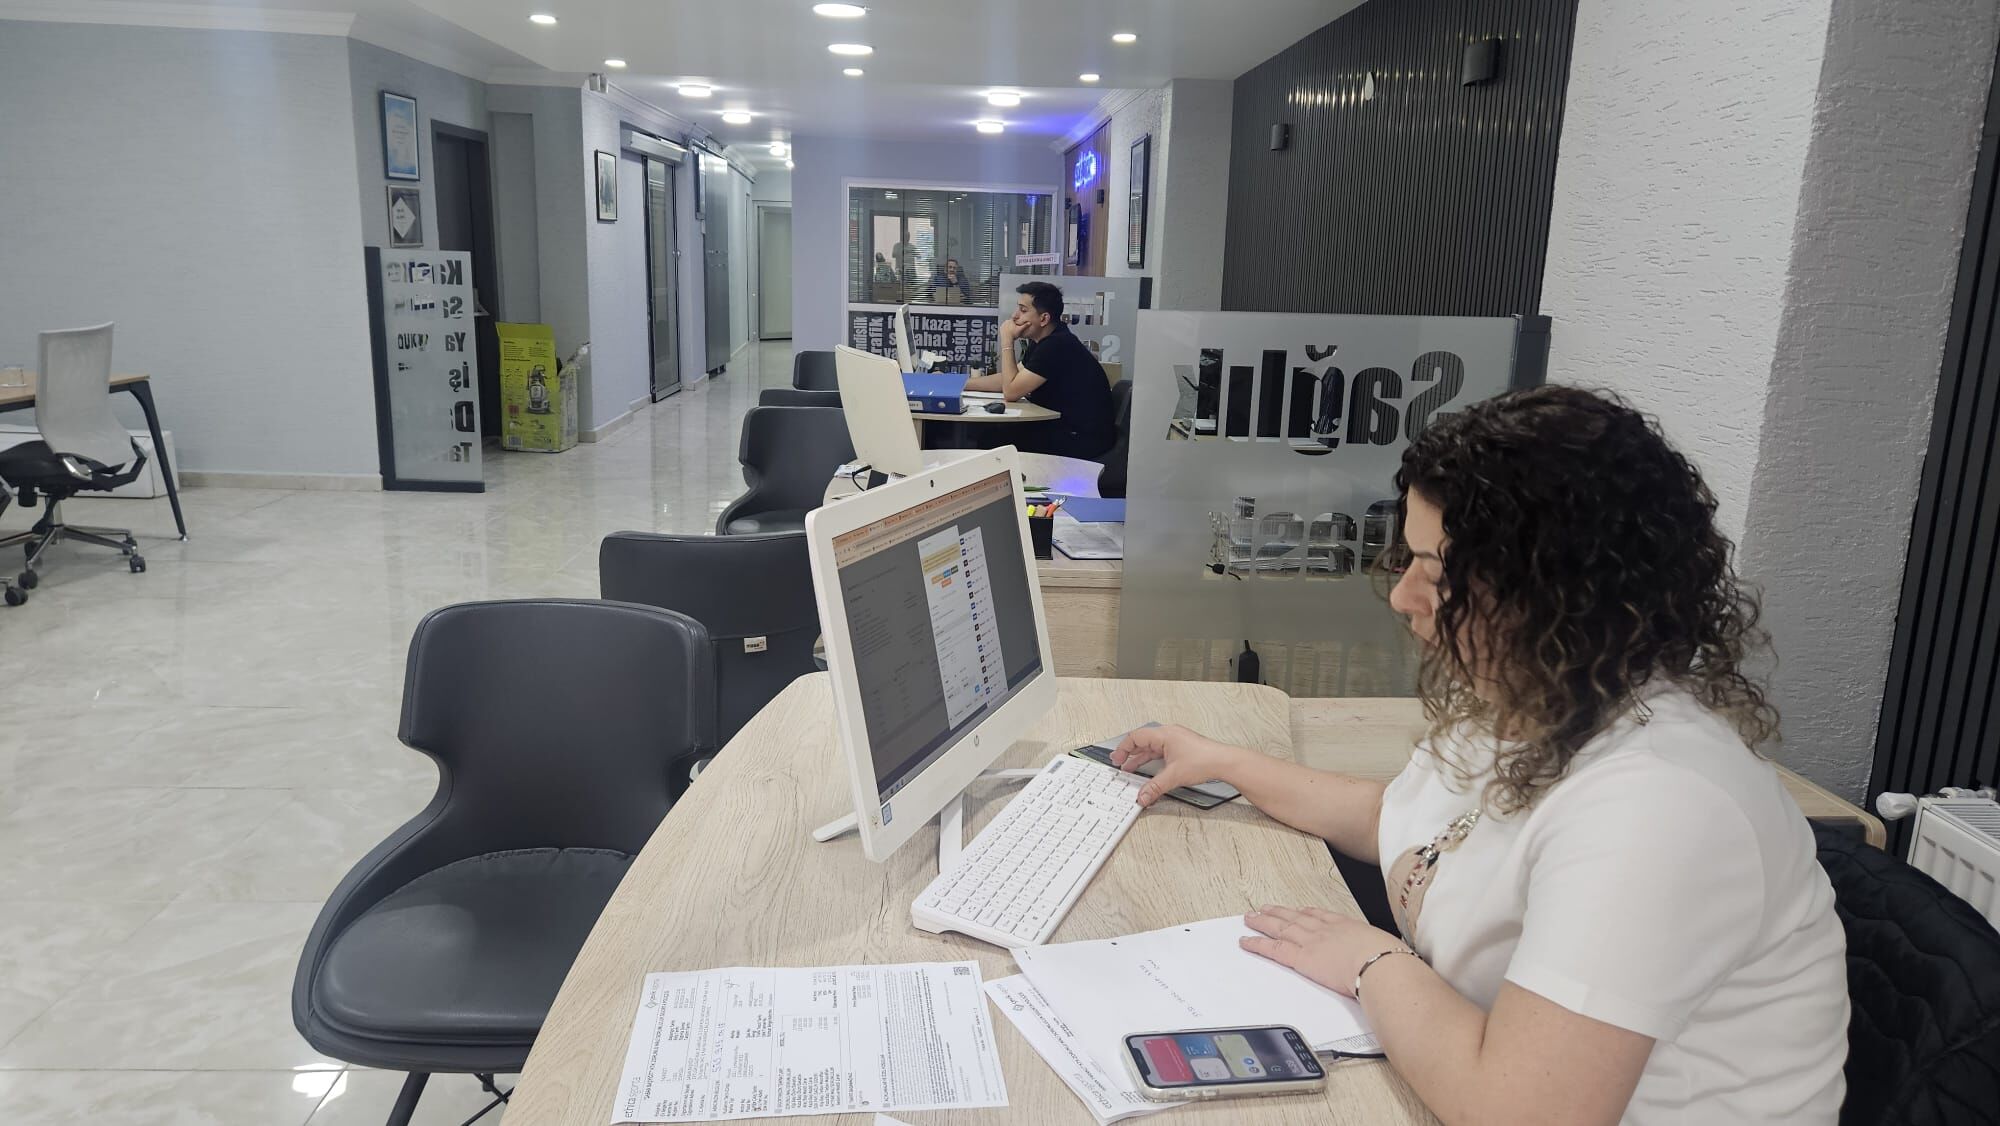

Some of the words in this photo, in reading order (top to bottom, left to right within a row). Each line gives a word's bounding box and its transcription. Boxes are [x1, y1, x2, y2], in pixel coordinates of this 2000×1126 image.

[869, 317, 884, 355] rafik
[888, 331, 948, 347] sahat
[922, 316, 951, 331] kaza
[952, 319, 968, 362] sağlık
[968, 319, 984, 361] kasko
